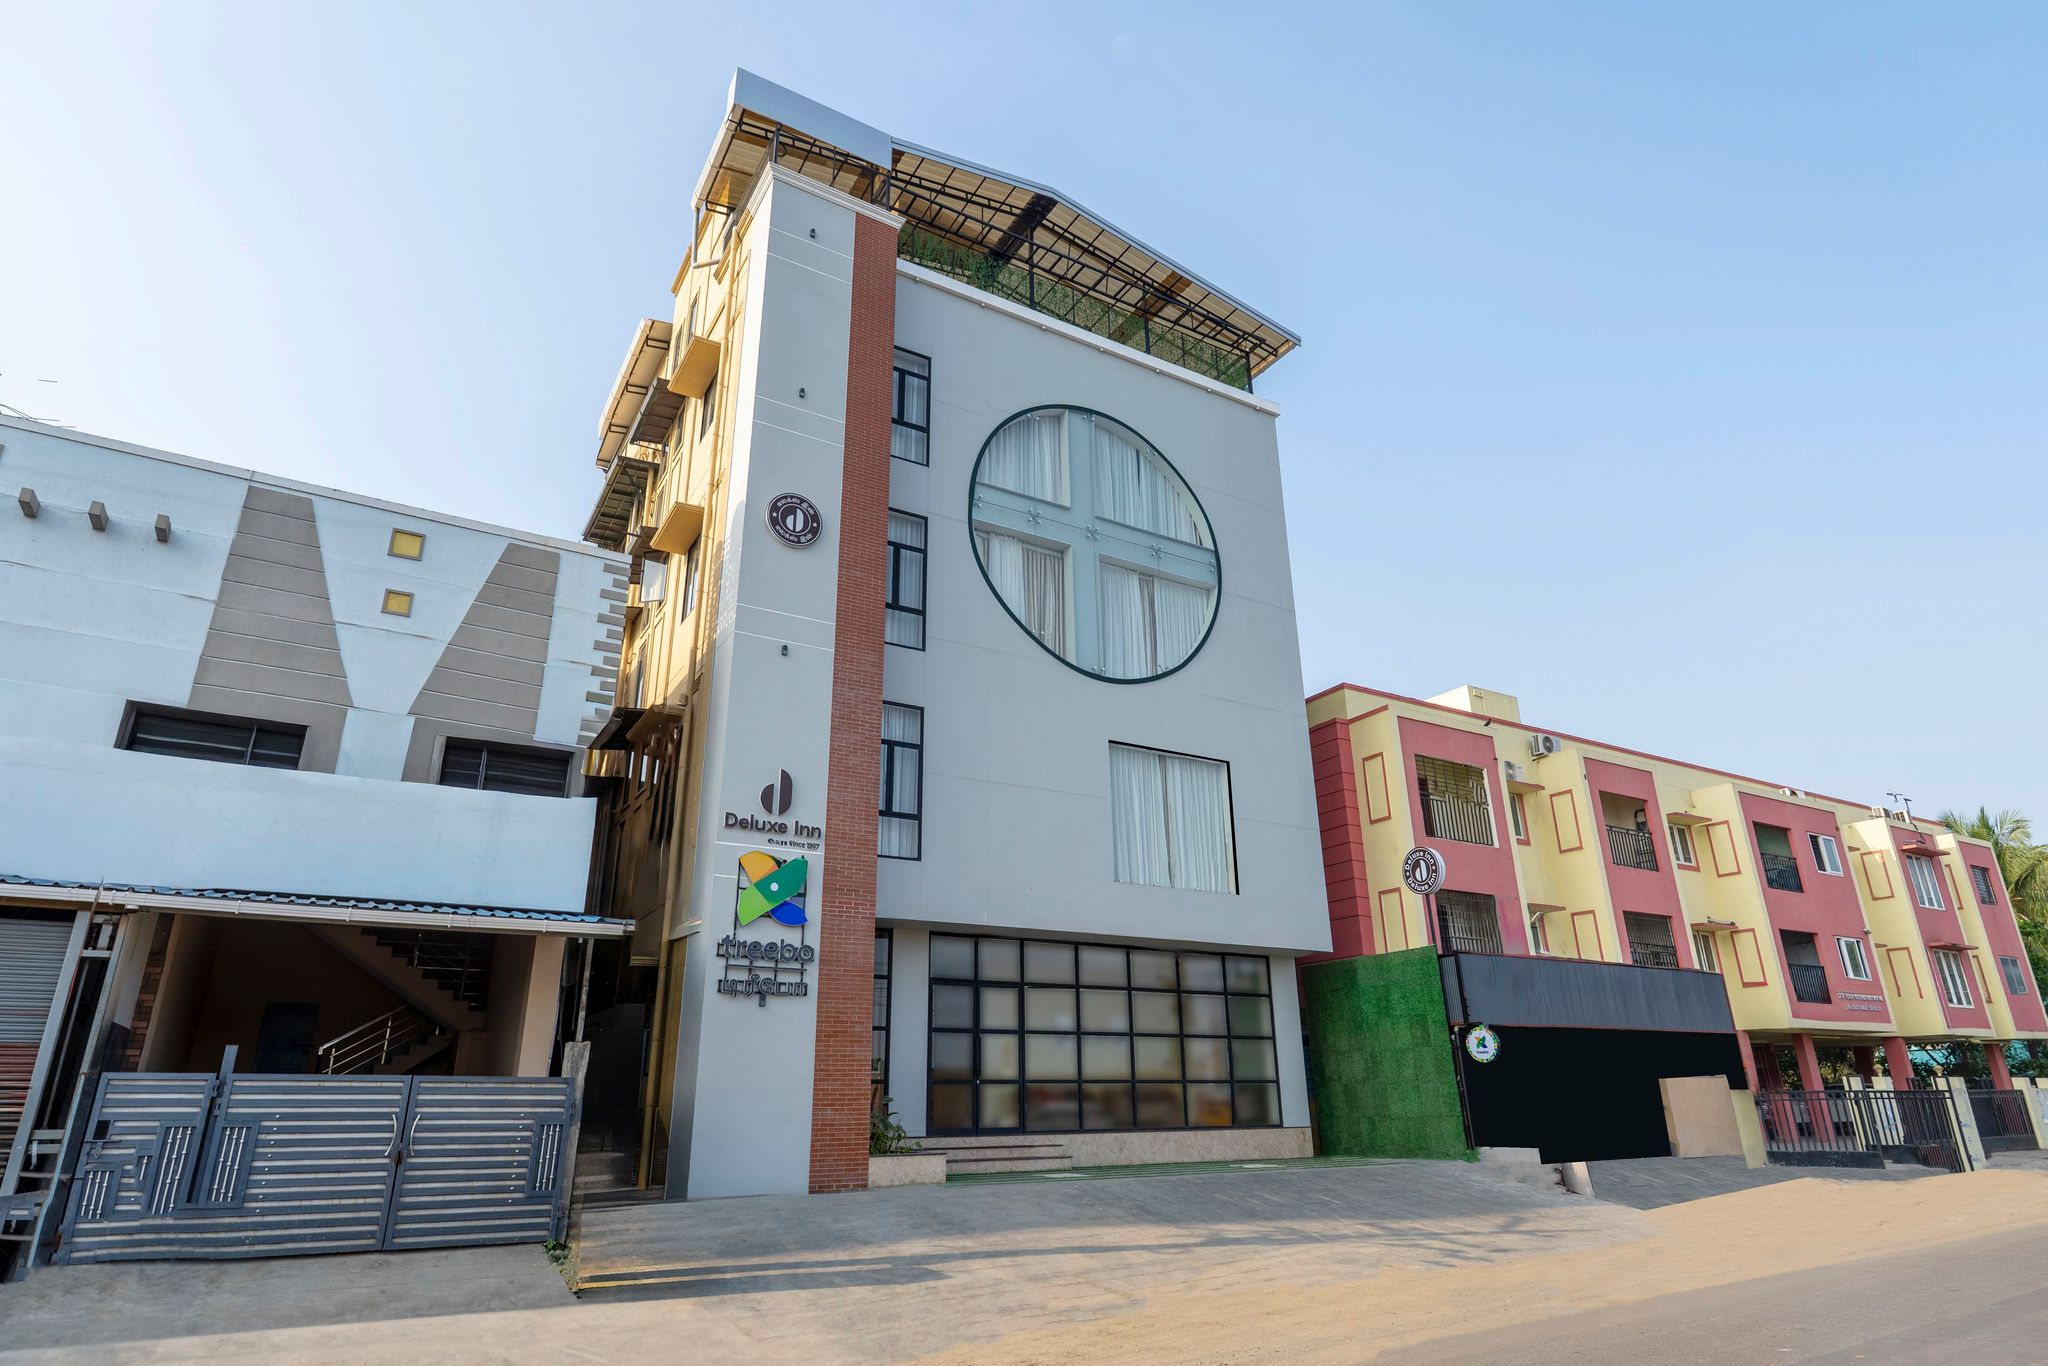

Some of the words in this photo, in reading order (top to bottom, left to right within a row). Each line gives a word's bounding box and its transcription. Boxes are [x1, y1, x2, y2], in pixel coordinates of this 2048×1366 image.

[724, 812, 788, 833] Deluxe
[794, 820, 822, 839] Inn
[1405, 851, 1424, 870] Deluxe
[1424, 851, 1435, 865] Inn
[1407, 877, 1429, 891] Deluxe
[1428, 872, 1437, 886] Inn
[721, 934, 815, 963] treebo
